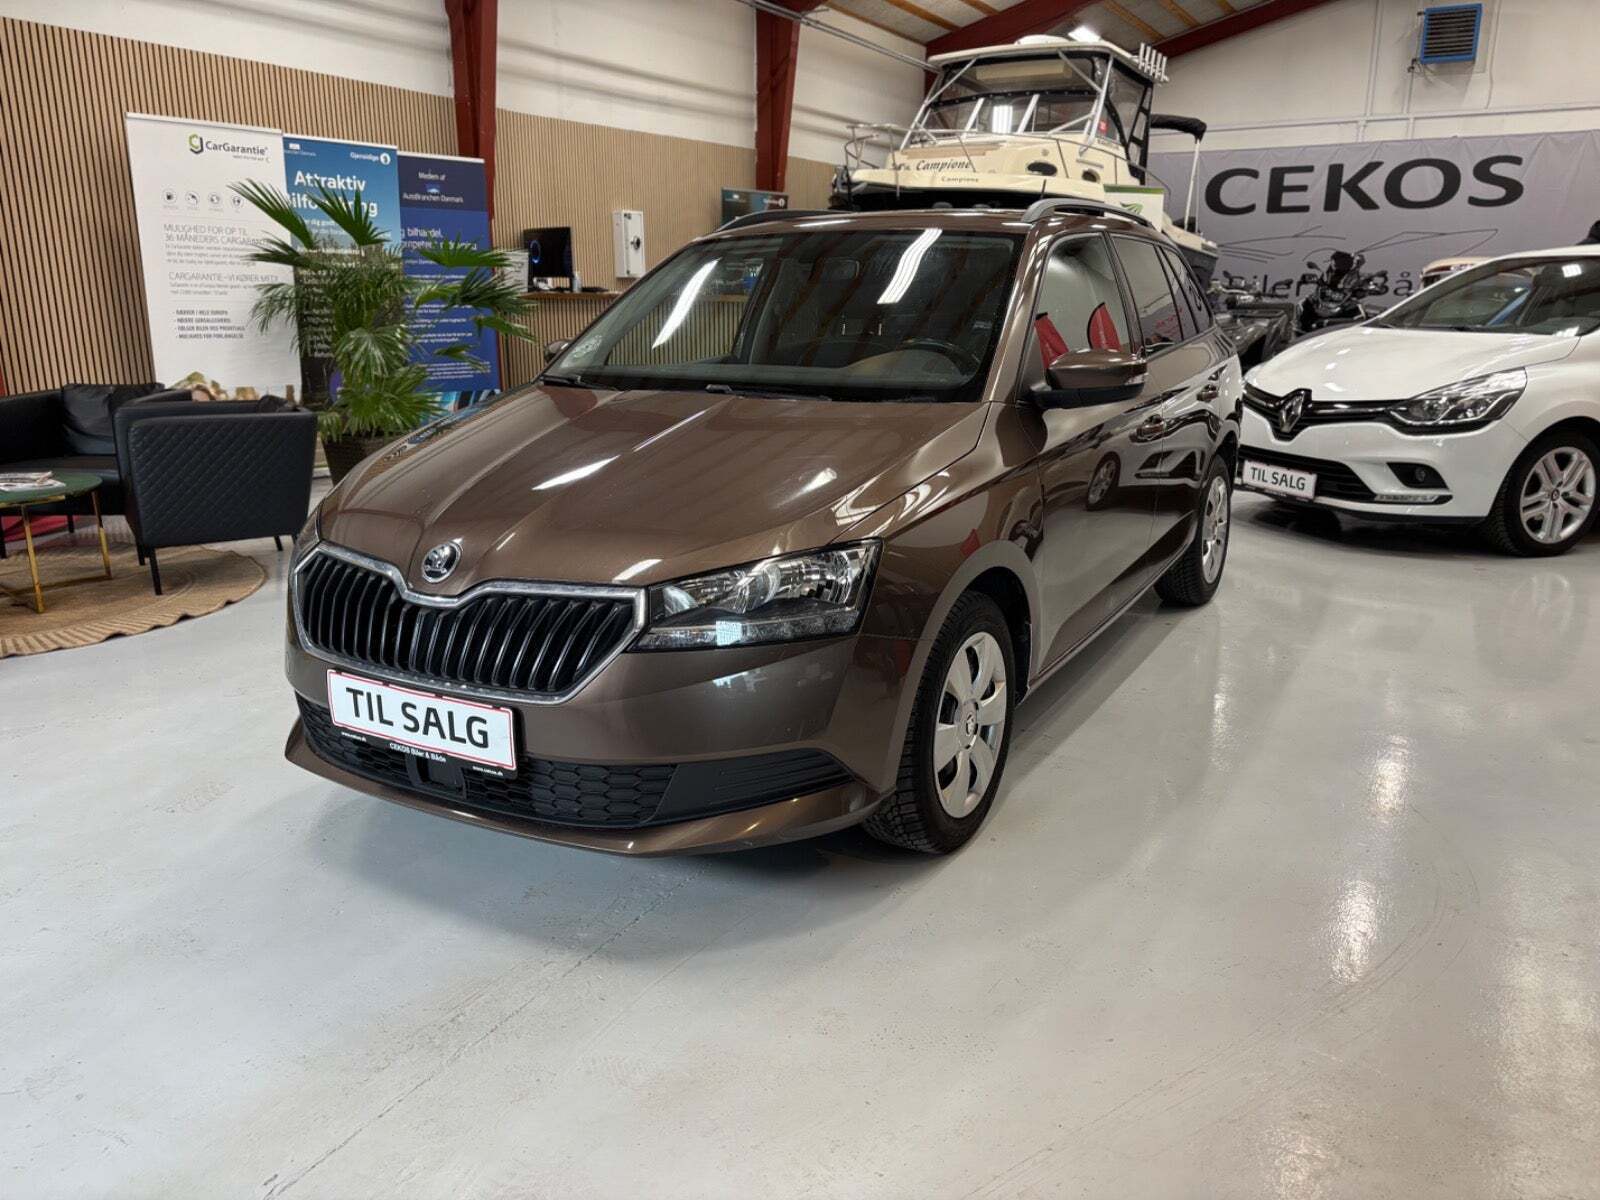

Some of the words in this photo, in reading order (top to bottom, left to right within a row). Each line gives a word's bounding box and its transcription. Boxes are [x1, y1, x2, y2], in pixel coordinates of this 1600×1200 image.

[1204, 154, 1524, 216] CEKOS
[1250, 467, 1268, 483] TIL
[1271, 472, 1306, 491] SALG
[346, 687, 394, 727] TIL
[400, 701, 489, 749] SALG
